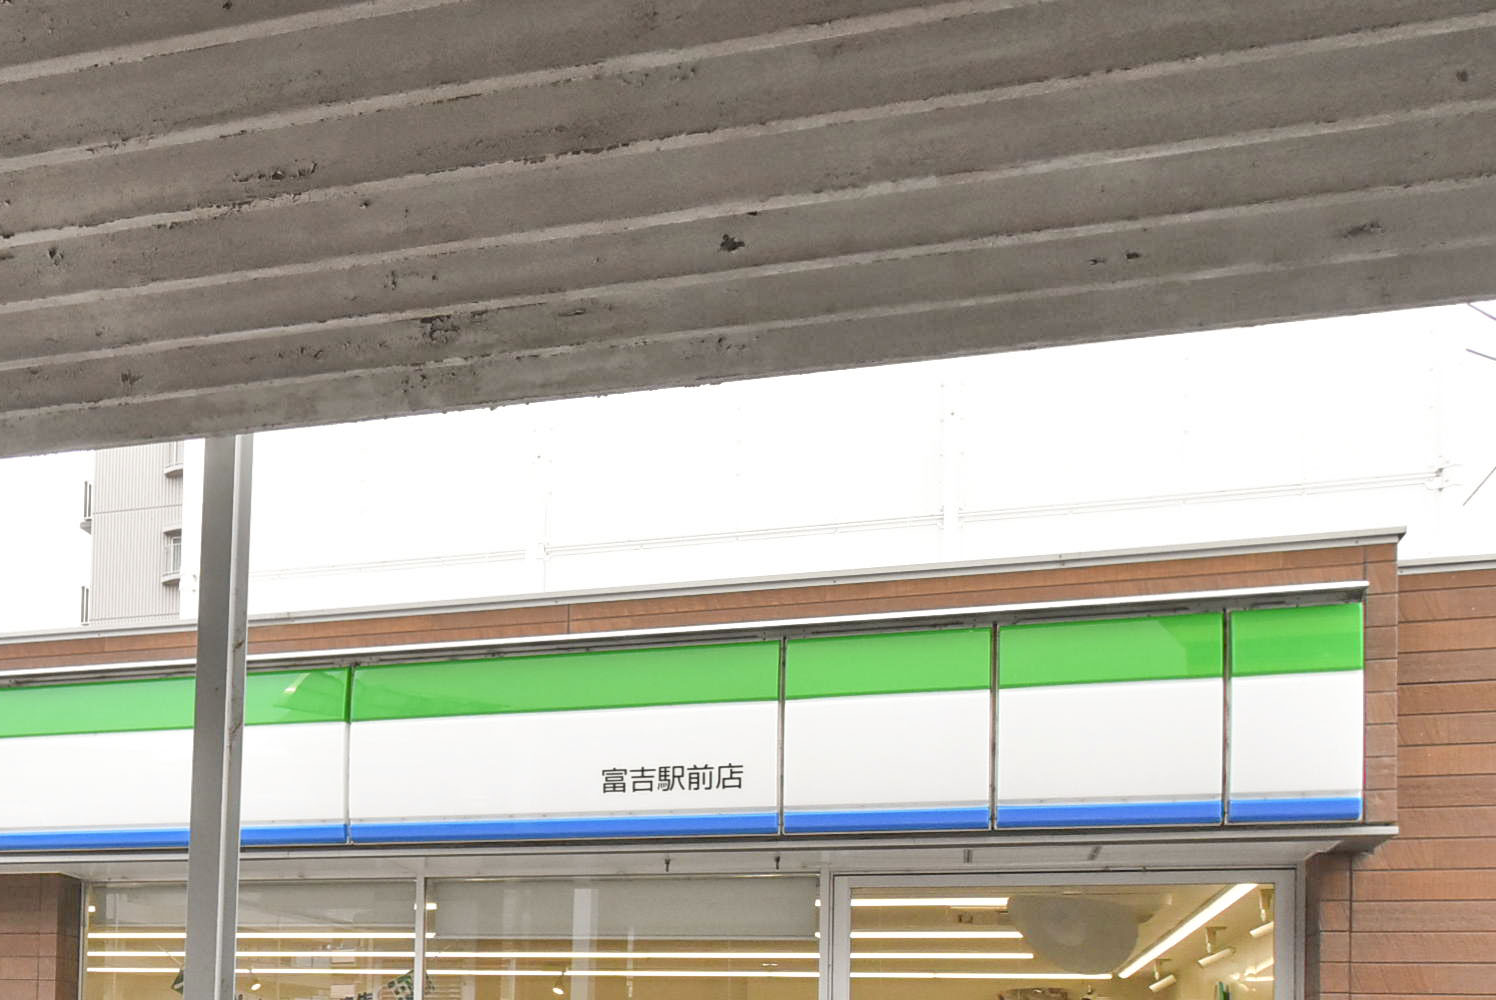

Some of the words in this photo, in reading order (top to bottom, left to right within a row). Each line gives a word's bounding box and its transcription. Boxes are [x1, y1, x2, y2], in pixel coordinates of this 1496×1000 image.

[601, 762, 744, 794] 富吉駅前店
